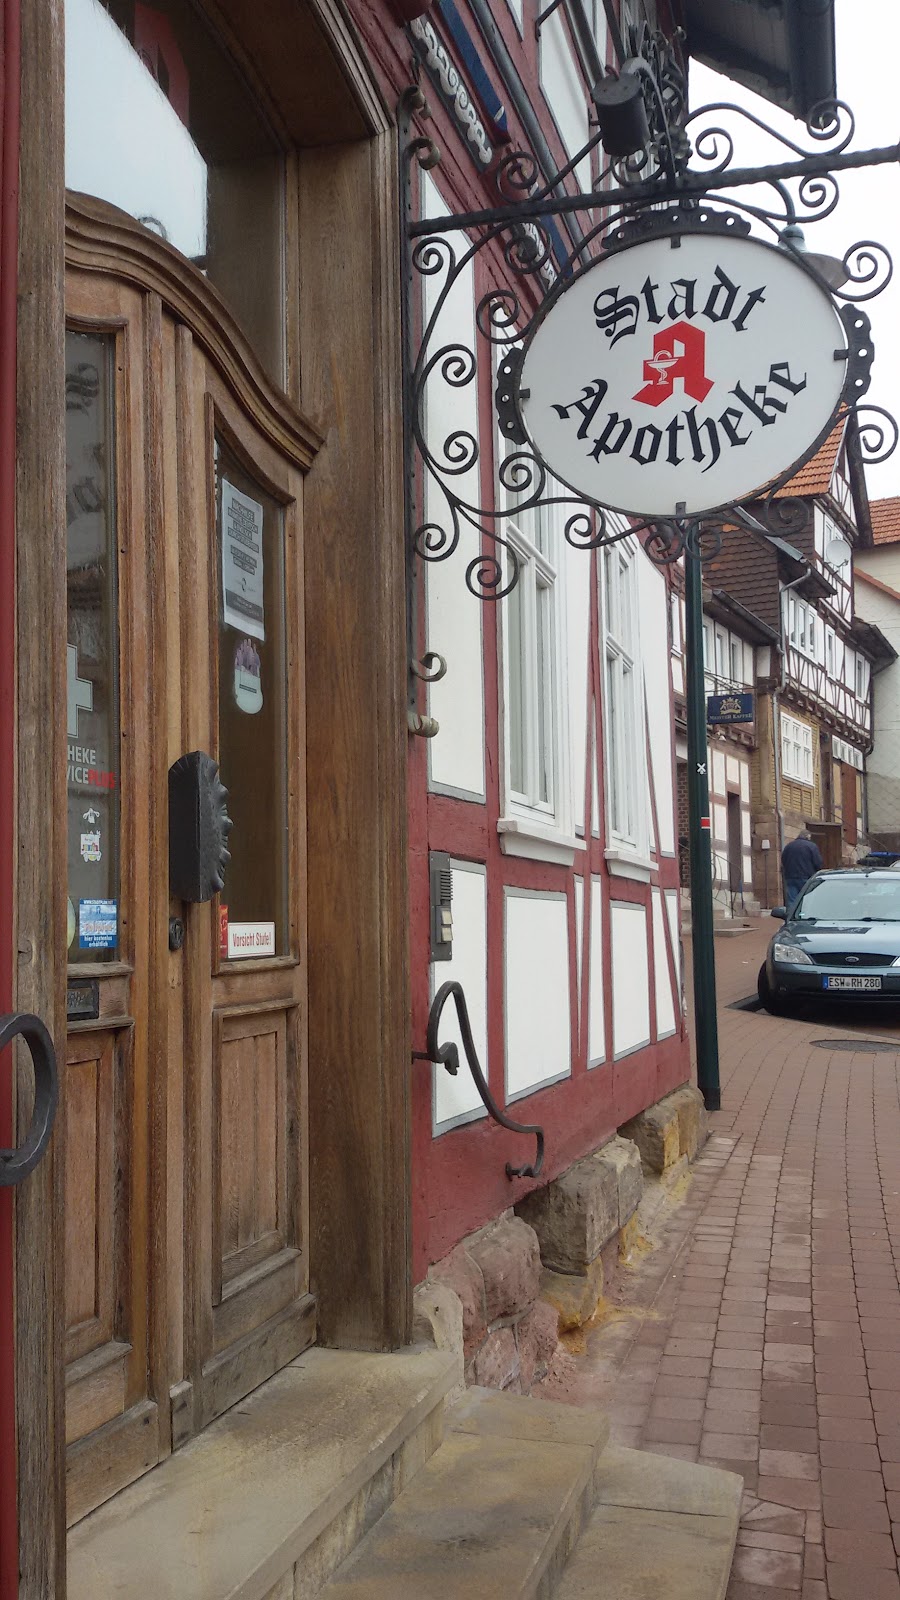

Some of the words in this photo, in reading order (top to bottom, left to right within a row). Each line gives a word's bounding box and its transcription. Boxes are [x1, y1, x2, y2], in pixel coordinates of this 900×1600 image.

[593, 265, 767, 350] Stadt
[631, 320, 715, 407] A
[550, 361, 807, 473] Apotheke
[232, 932, 255, 947] Vorsicht
[829, 977, 845, 987] ESW
[851, 978, 863, 988] RH
[864, 978, 881, 988] 280
